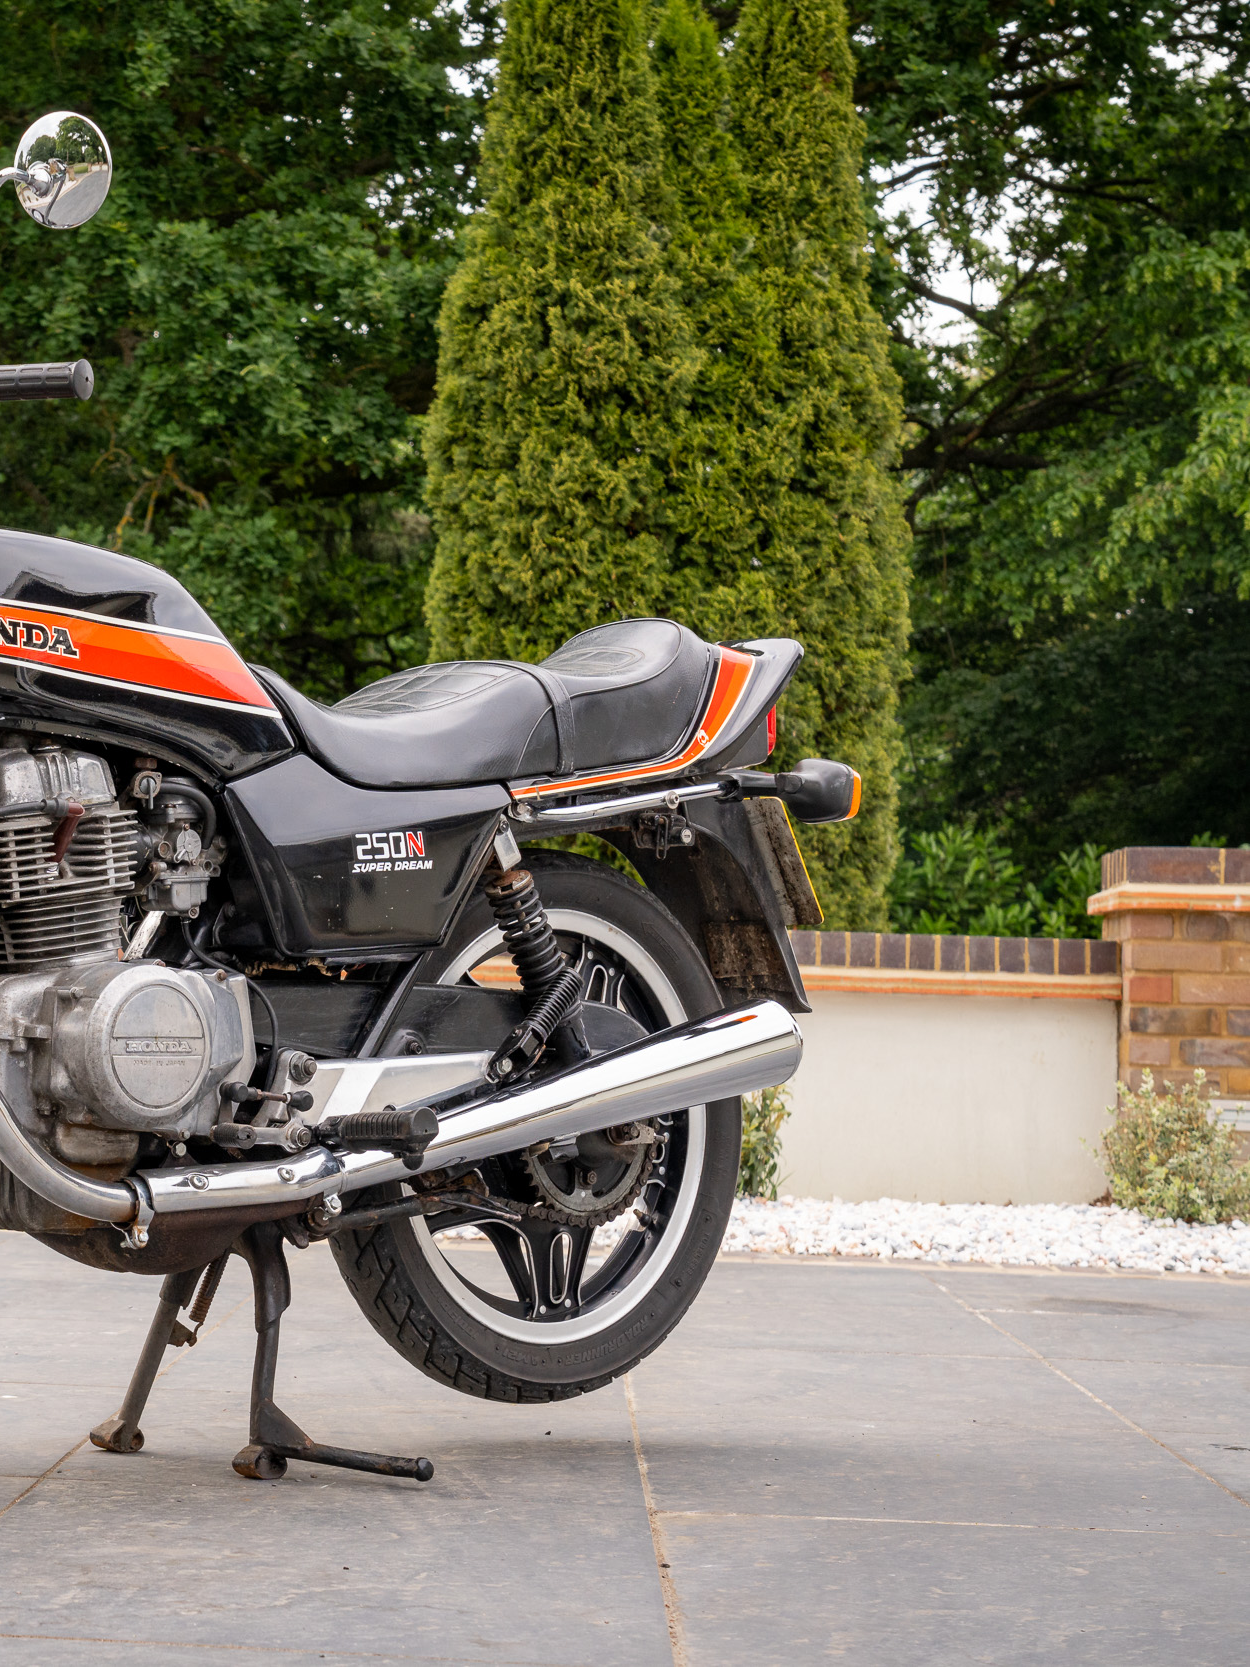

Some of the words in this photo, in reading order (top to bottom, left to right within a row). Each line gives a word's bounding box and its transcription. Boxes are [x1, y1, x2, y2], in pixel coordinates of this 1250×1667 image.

[355, 831, 425, 860] 250N
[352, 862, 392, 873] SUPER
[394, 860, 433, 871] DREAM
[126, 1040, 192, 1053] HONDA
[565, 1313, 650, 1370] ROADRUNNER
